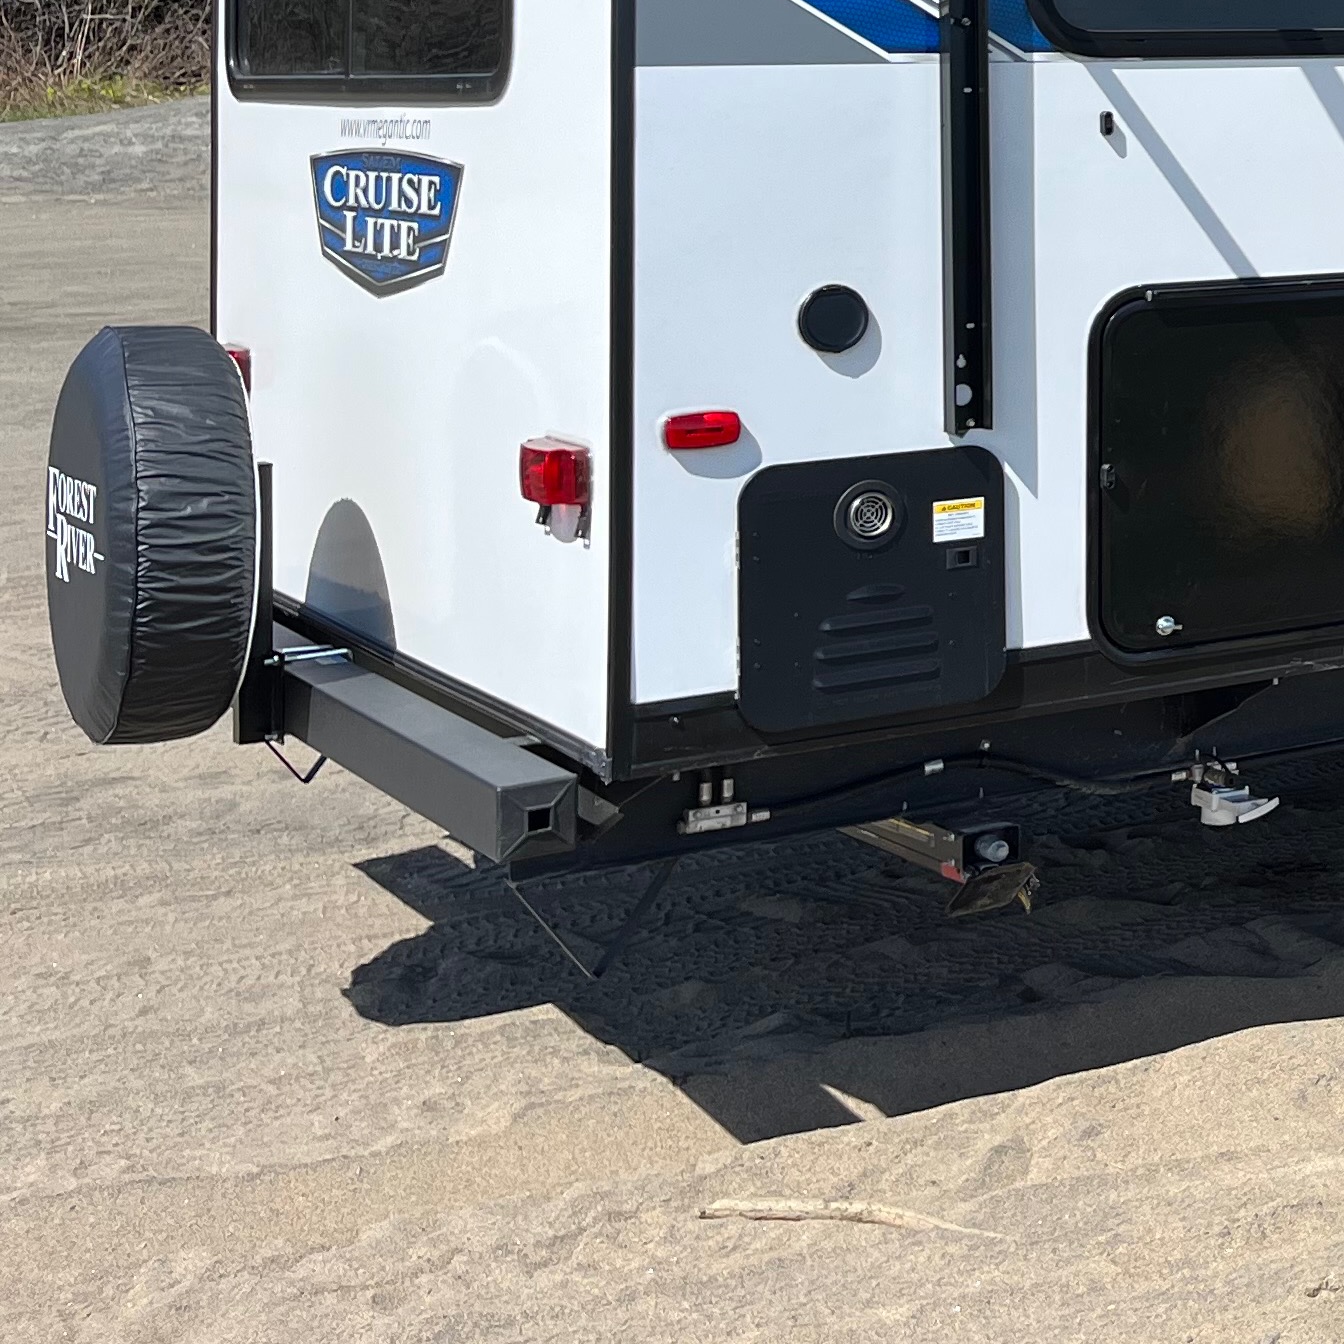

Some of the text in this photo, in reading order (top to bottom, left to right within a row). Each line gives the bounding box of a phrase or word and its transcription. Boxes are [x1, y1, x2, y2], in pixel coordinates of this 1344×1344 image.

[340, 114, 431, 146] www.vrmegantic.com
[323, 164, 441, 216] CRUISE
[342, 210, 420, 262] LITE
[47, 465, 97, 531] FOREST
[55, 513, 96, 583] RIVER
